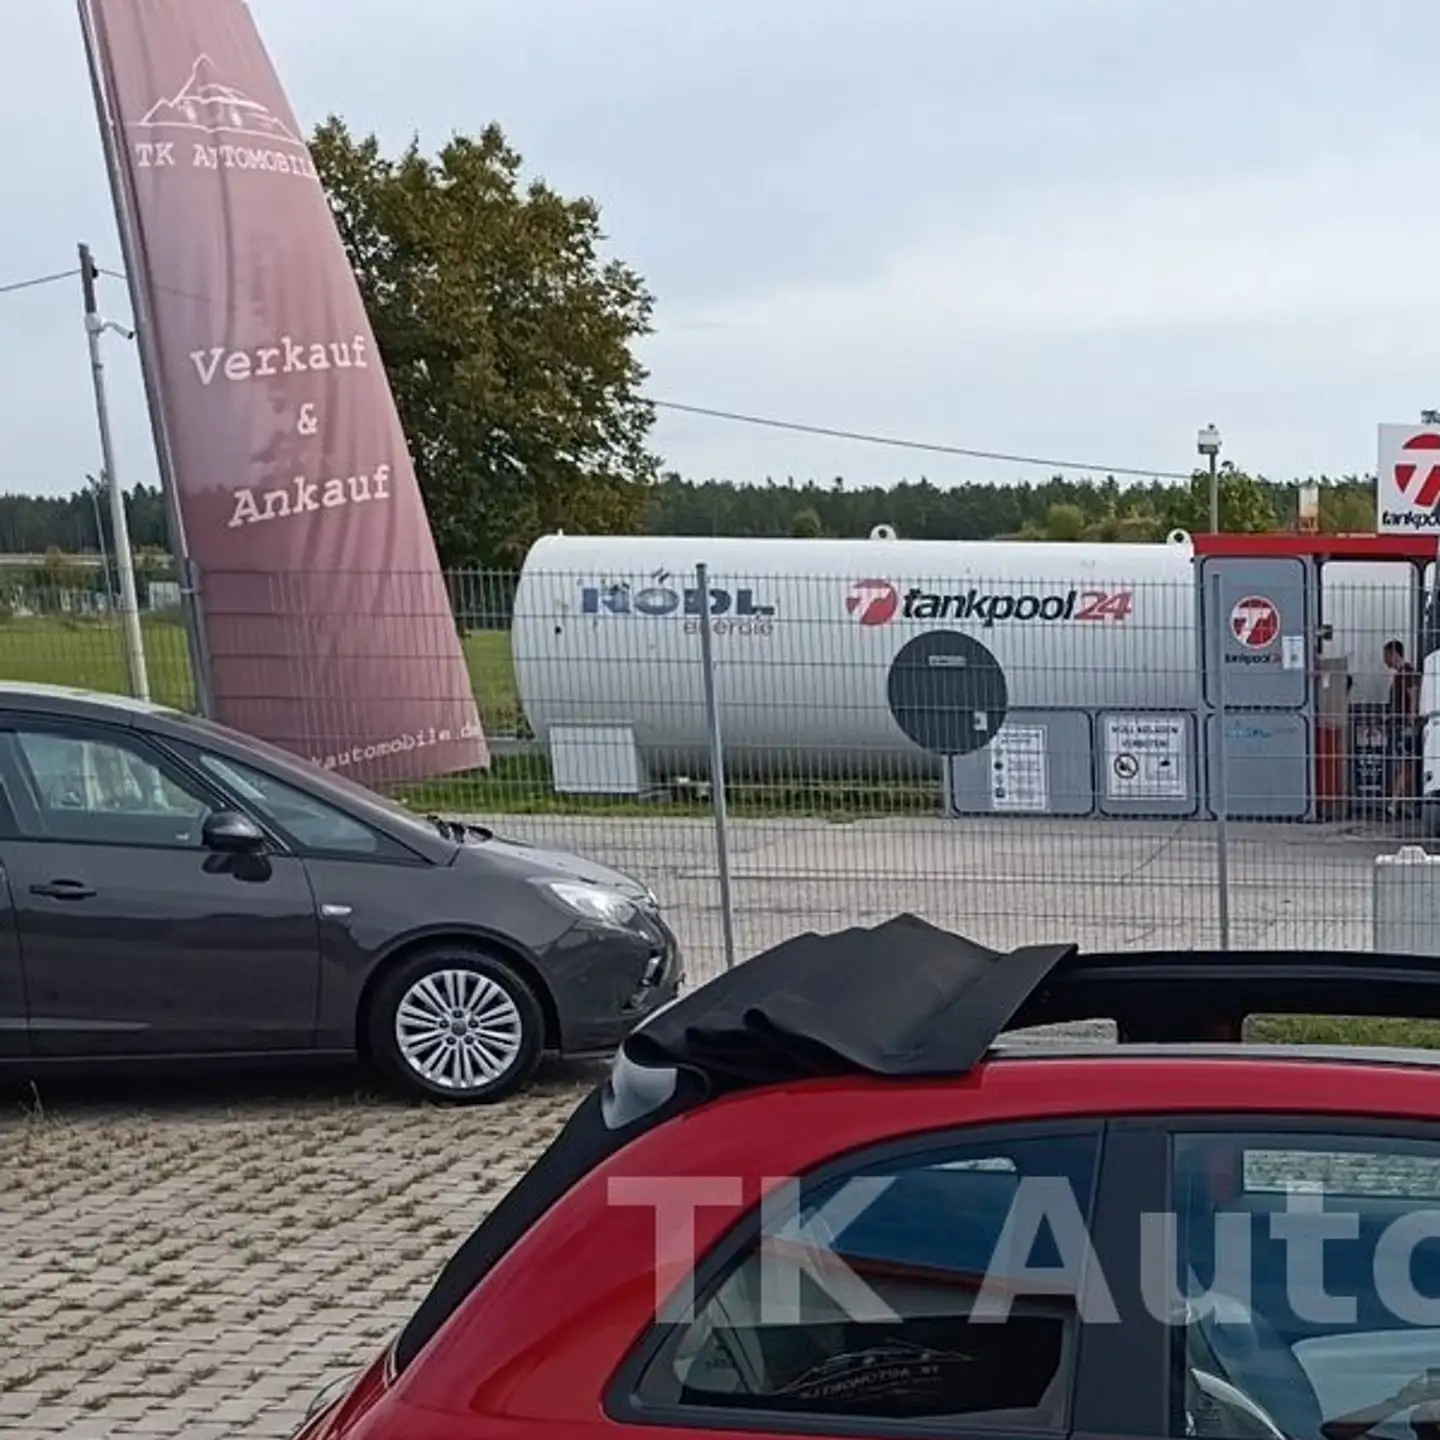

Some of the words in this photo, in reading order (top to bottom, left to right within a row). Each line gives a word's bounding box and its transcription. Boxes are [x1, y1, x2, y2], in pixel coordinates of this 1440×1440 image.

[134, 141, 175, 168] TK
[189, 335, 368, 386] Verkauf
[297, 402, 319, 435] &
[227, 463, 391, 528] Ankauf
[902, 587, 1133, 628] tankpool24
